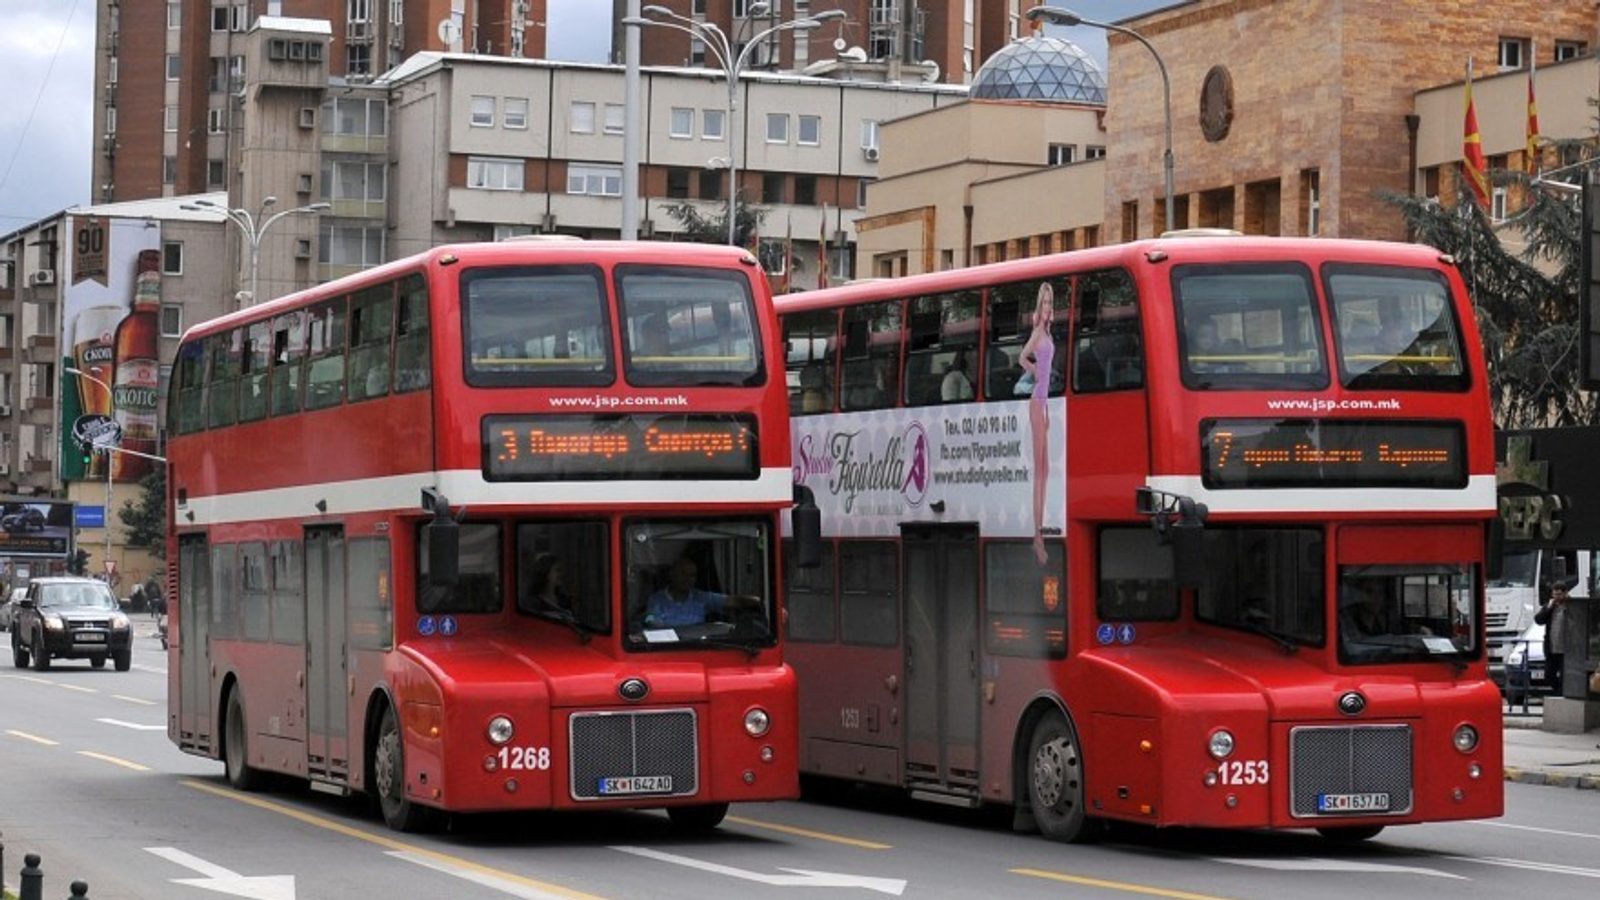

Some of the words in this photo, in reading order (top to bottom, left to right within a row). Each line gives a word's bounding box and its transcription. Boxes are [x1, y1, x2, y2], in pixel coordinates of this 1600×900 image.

[78, 228, 103, 255] 90
[549, 395, 688, 408] www.jsp.com.mk
[1267, 398, 1401, 411] www.jsp.com.mk
[1214, 432, 1232, 467] 7
[829, 430, 905, 514] Figurella
[498, 747, 550, 770] 1268
[1218, 761, 1269, 784] 1253
